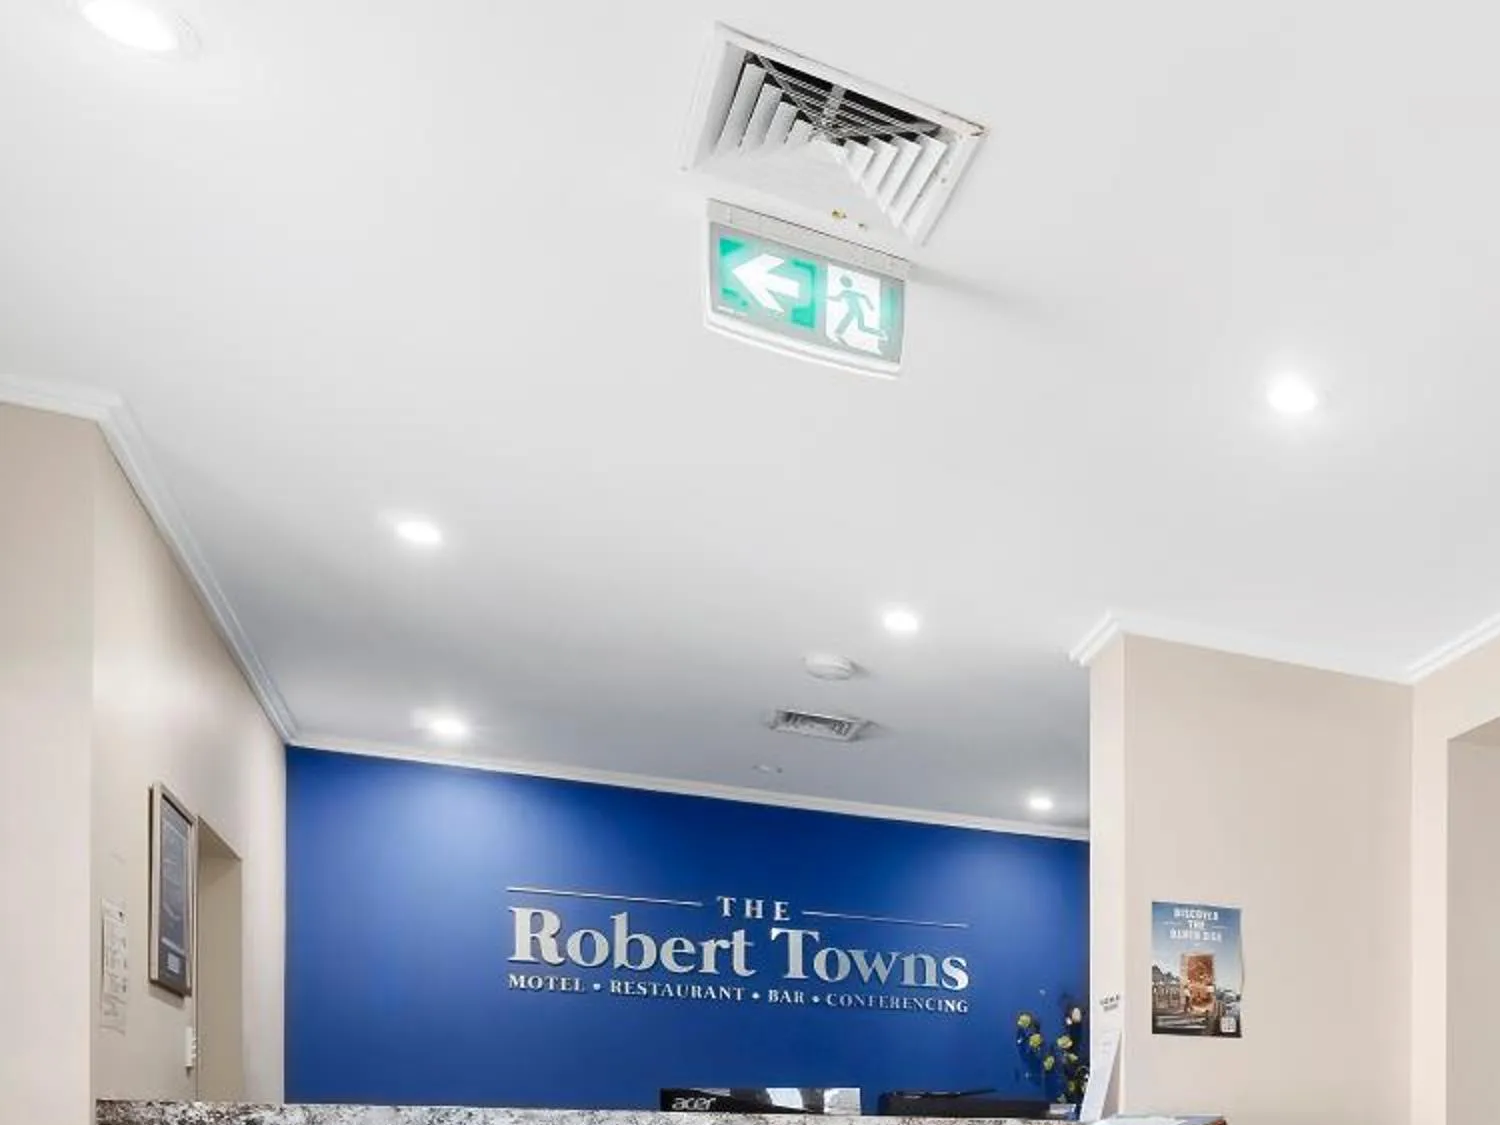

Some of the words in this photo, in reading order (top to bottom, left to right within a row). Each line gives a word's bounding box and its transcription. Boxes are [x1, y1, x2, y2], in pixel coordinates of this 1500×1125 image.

[717, 896, 791, 921] THE
[507, 905, 757, 977] Robert
[771, 927, 969, 991] Towns
[507, 973, 585, 992] MOTEL
[610, 980, 745, 1001] RESTAURANT
[768, 989, 805, 1004] BAR
[827, 993, 969, 1014] CONFERENCING
[671, 1097, 717, 1110] acer
